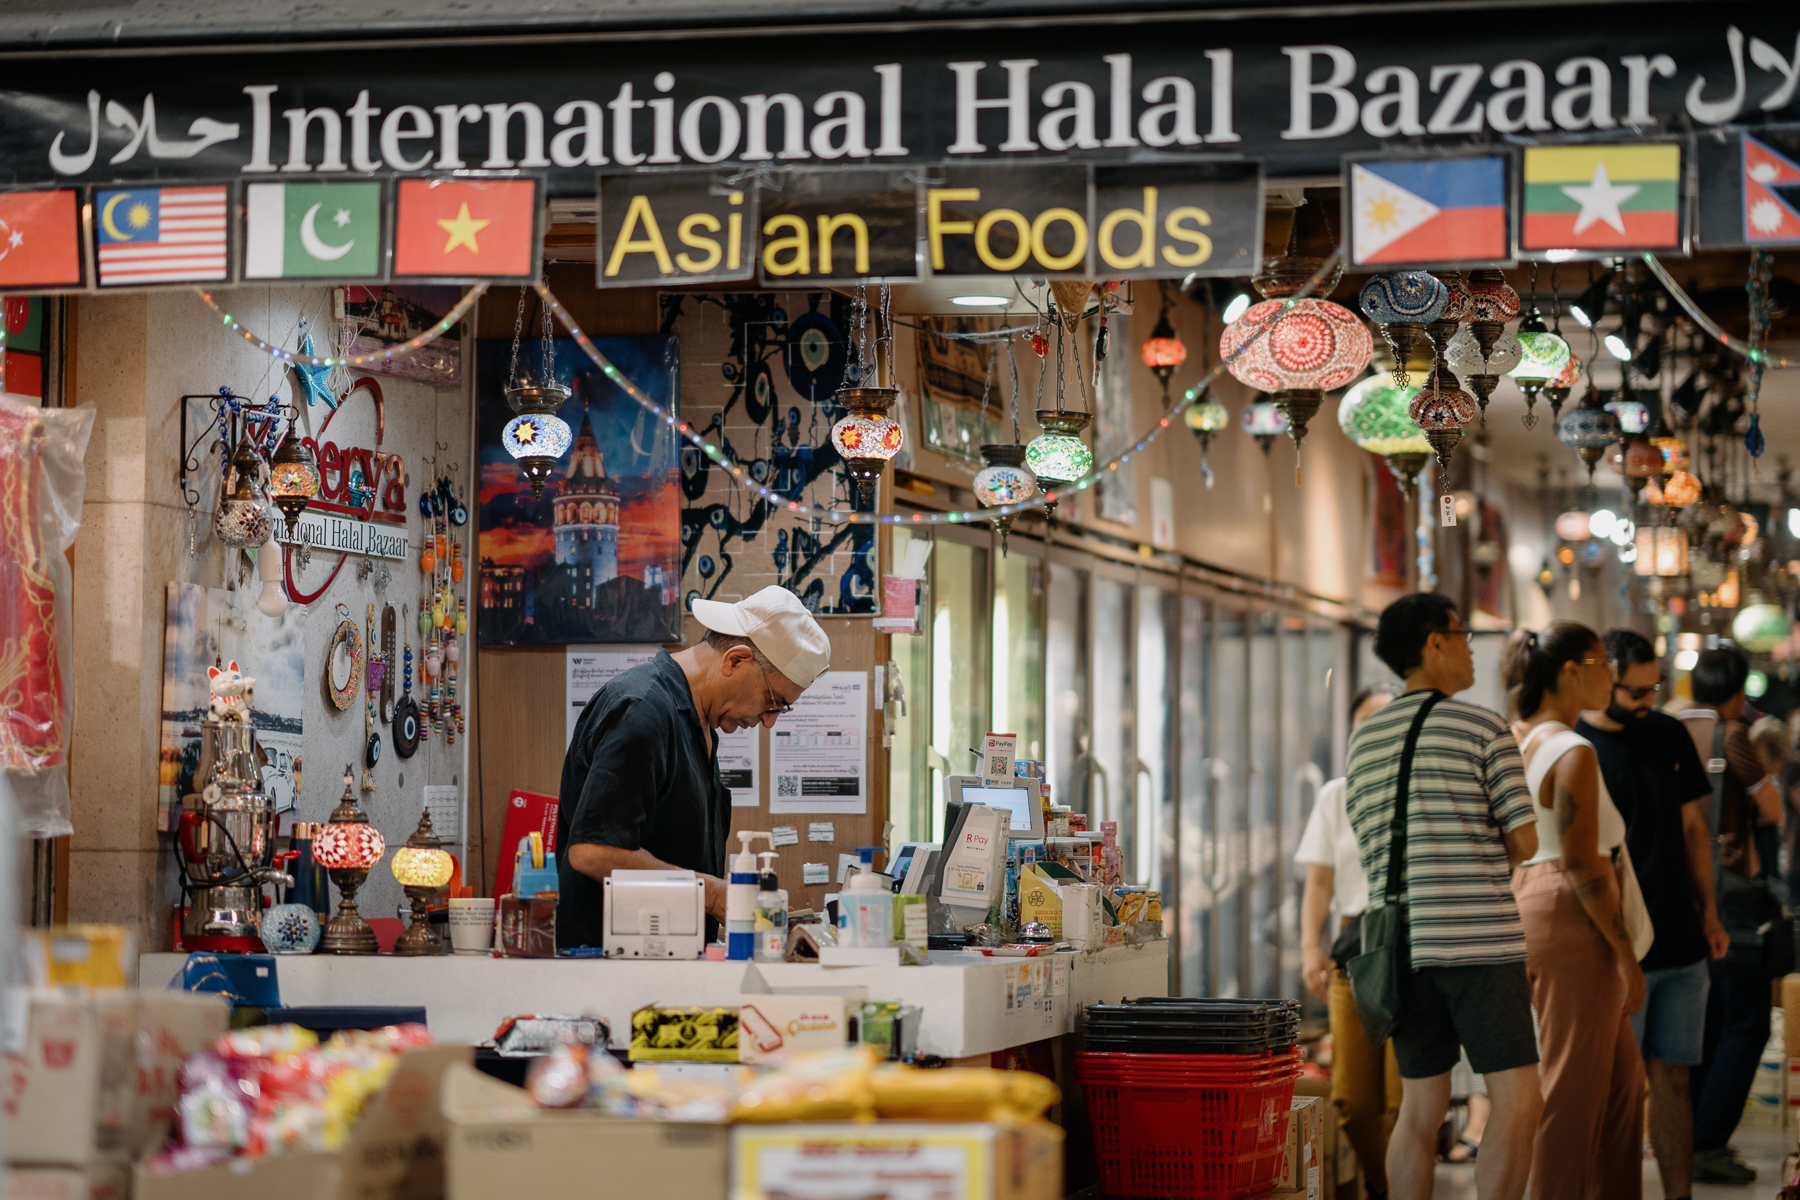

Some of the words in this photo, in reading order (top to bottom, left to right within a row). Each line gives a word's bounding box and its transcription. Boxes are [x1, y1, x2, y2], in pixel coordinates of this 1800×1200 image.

[242, 63, 908, 172] International
[948, 48, 1241, 153] Halal
[1281, 44, 1677, 140] Bazaar
[48, 89, 240, 175] حلال
[605, 191, 870, 276] Asian
[927, 186, 1213, 271] Foods
[331, 519, 364, 551] Halal
[367, 525, 409, 557] Bazaar
[995, 740, 1013, 748] PayPay
[547, 804, 558, 846] POLYETHYLENE
[966, 833, 973, 843] R
[974, 834, 989, 845] Pay
